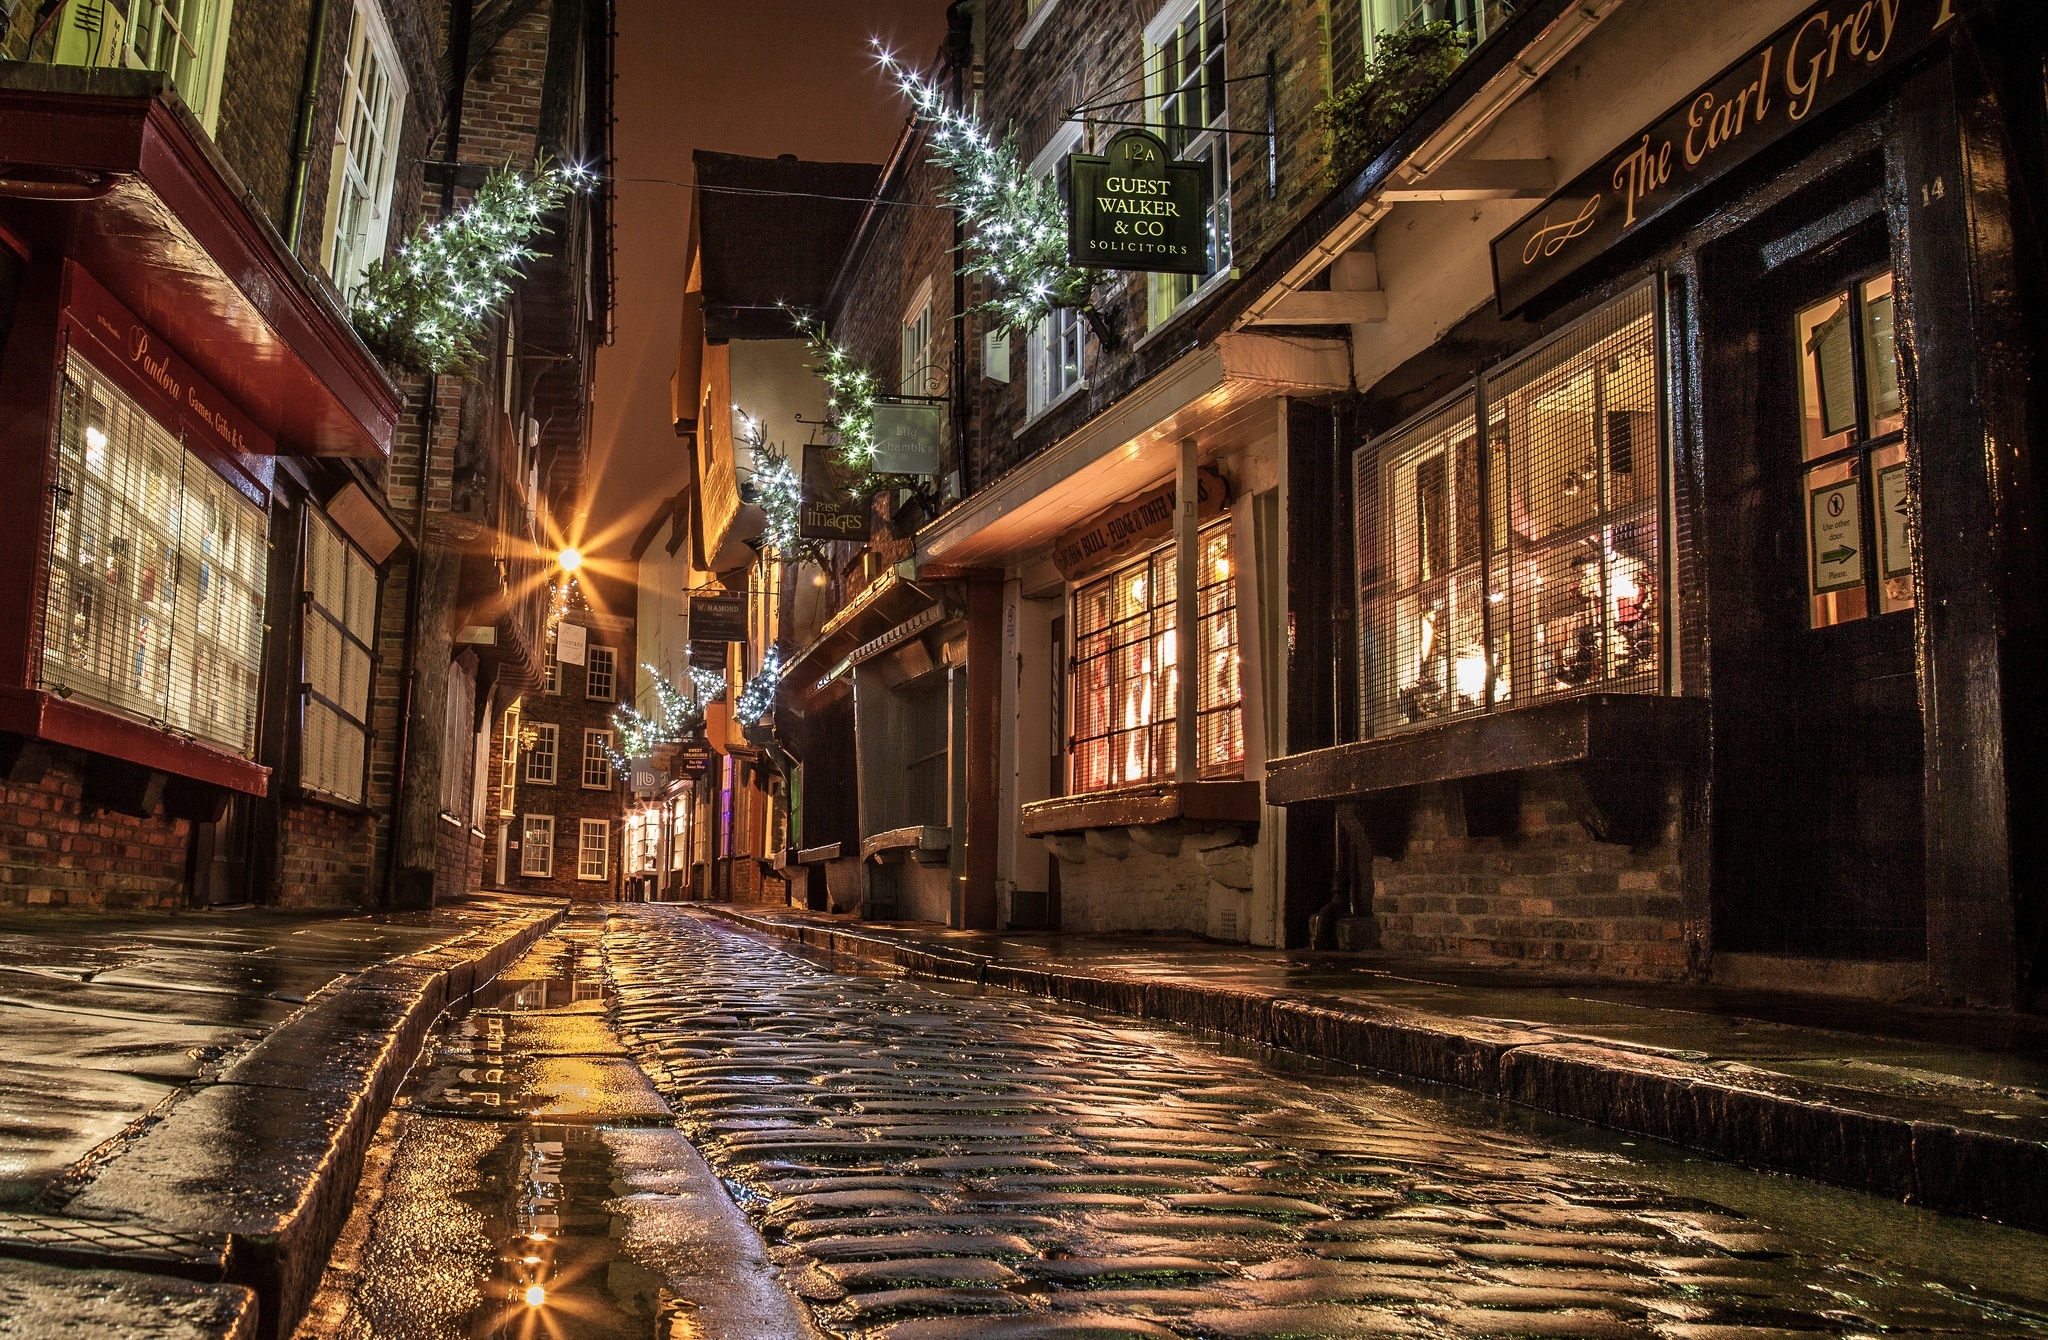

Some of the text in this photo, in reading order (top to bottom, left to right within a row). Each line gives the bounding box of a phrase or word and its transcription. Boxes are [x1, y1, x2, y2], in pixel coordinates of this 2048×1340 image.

[1613, 0, 1899, 229] The Earl Grey
[1123, 143, 1155, 161] 12A
[1106, 177, 1171, 195] GUEST
[1920, 175, 1946, 207] 14
[1097, 197, 1180, 217] WALKER
[1114, 220, 1164, 236] & CO
[1090, 240, 1187, 255] SOLICITORS
[128, 325, 181, 400] Pandora
[188, 387, 214, 428] Games,
[215, 412, 231, 442] Gifts
[231, 429, 237, 448] &
[896, 425, 917, 439] Lily
[879, 440, 934, 453] Shambles
[816, 501, 841, 512] Past
[1060, 541, 1084, 569] JOHN
[1080, 528, 1107, 557] BULL
[1107, 513, 1136, 541] FUDGE
[1138, 496, 1170, 527] TOFFEE
[1822, 519, 1850, 532] Use other
[1828, 532, 1845, 541] door.
[1828, 571, 1848, 580] Please.
[560, 638, 584, 648] silverado
